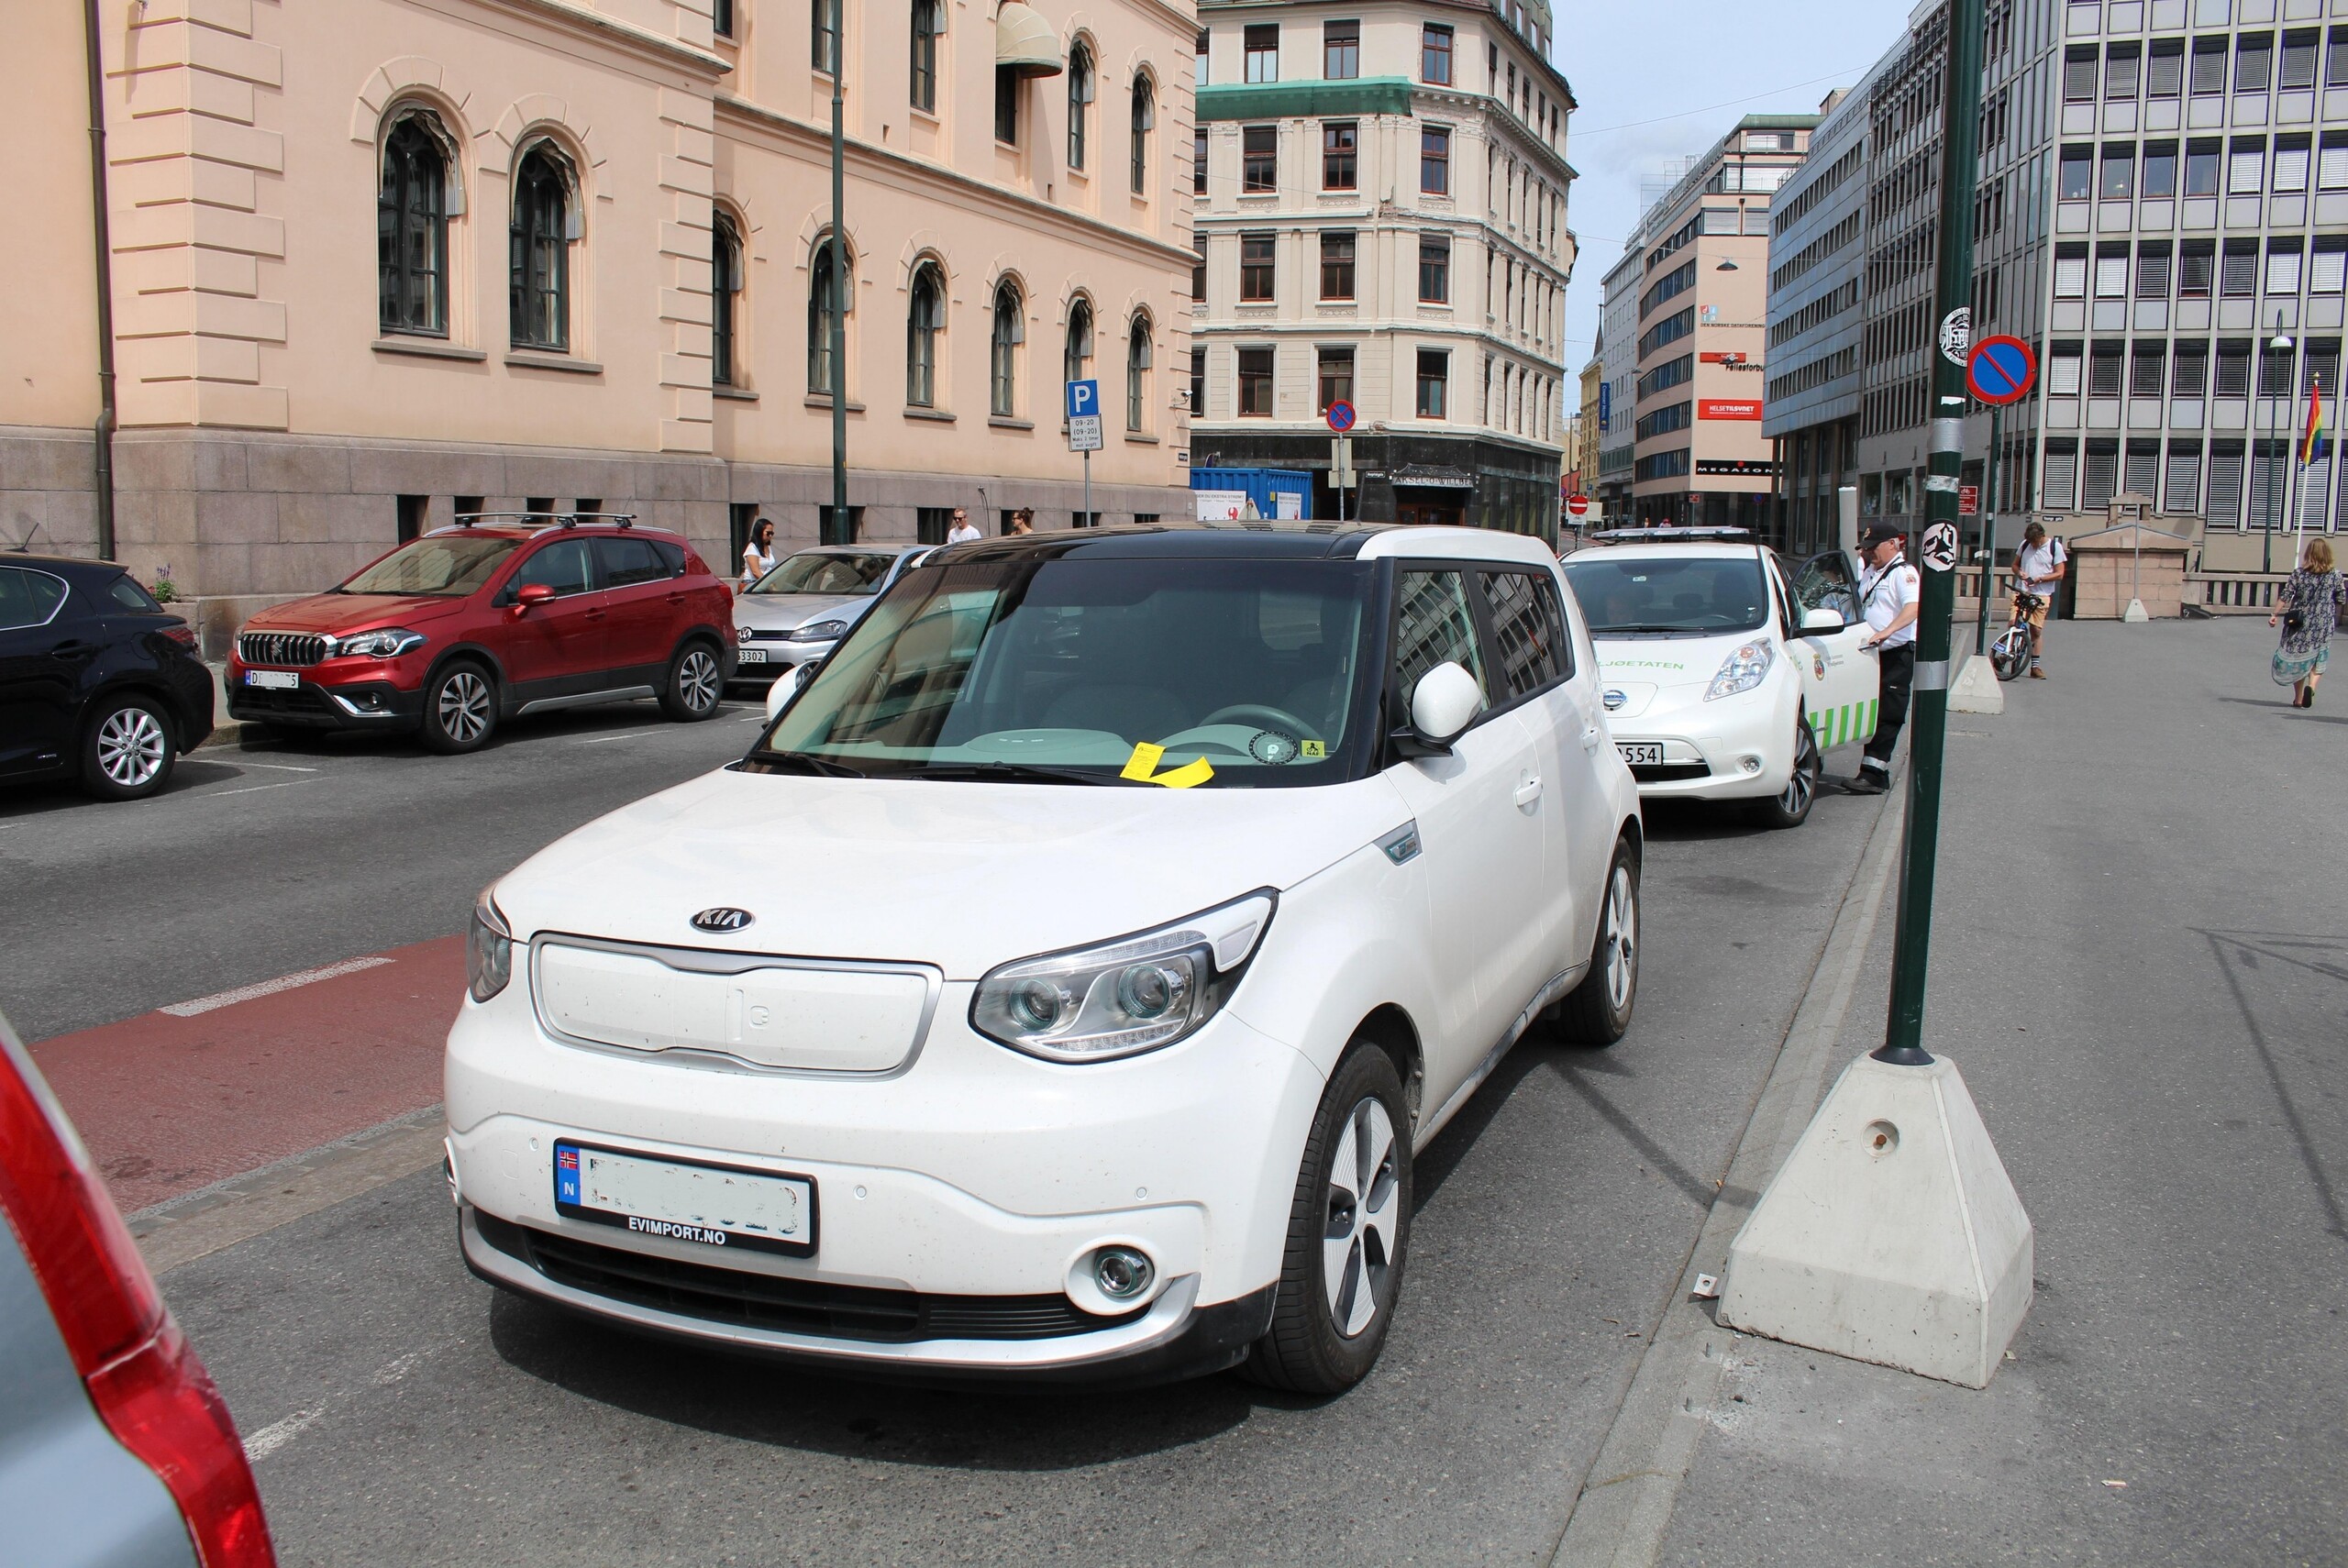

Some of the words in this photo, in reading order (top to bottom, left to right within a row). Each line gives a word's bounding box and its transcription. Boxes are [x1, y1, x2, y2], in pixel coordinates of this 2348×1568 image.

[1074, 385, 1091, 413] P
[1075, 418, 1094, 426] 09-20
[1073, 427, 1098, 436] (09-20)
[1394, 476, 1423, 485] AKSEL
[696, 909, 743, 928] KIA
[564, 1181, 575, 1197] N
[628, 1216, 726, 1246] EVIMPORT.NO
